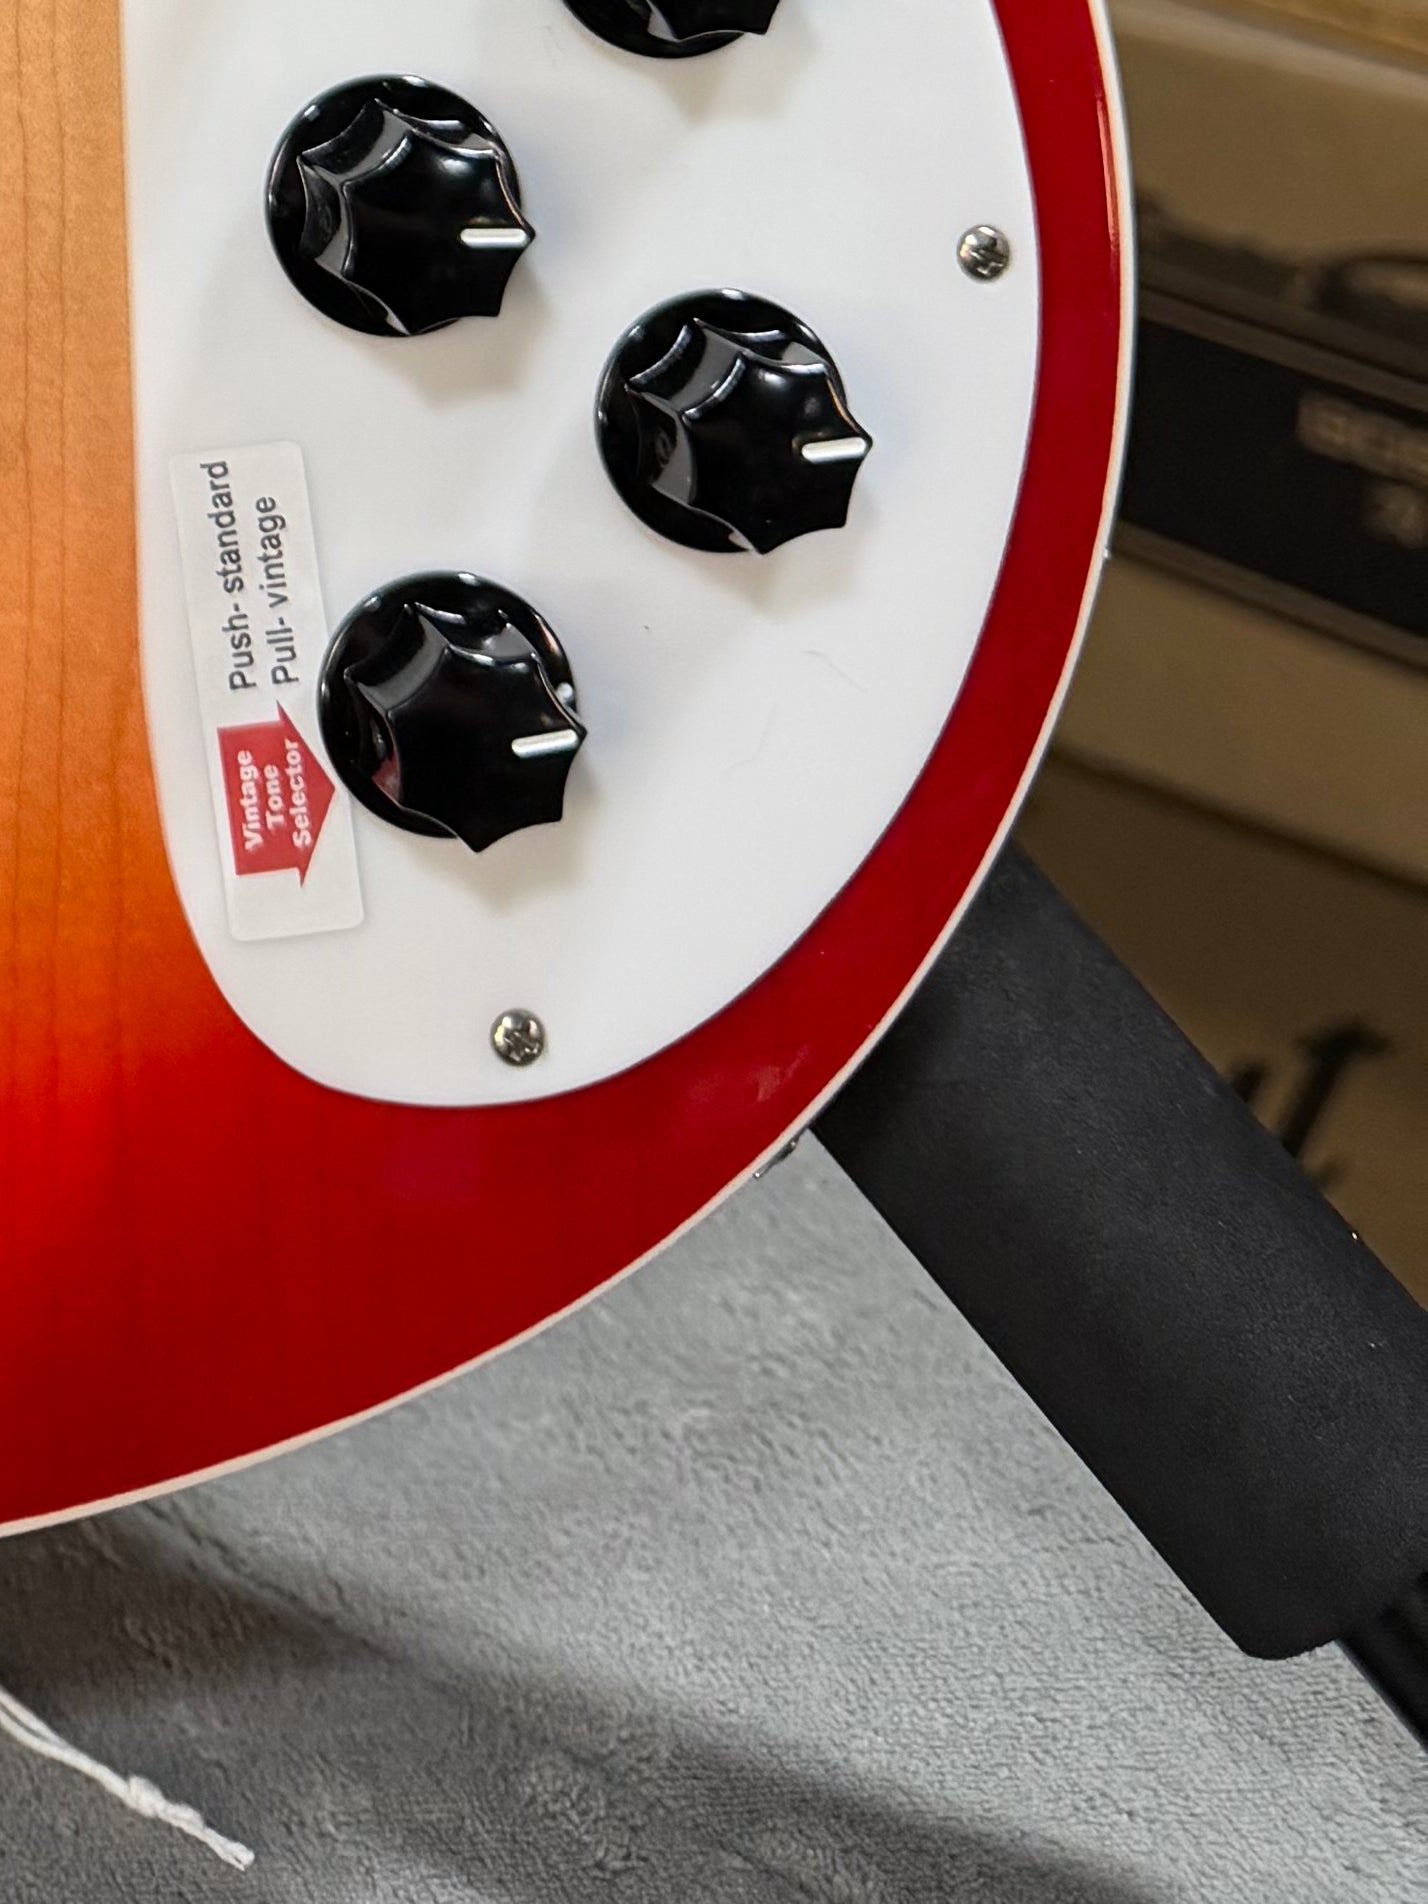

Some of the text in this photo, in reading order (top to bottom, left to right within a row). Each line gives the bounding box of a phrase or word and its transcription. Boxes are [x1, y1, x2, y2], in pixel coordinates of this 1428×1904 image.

[199, 460, 257, 691] Push- standard
[255, 496, 299, 685] Pull- vintage
[237, 749, 264, 851] Vintage
[264, 763, 287, 831] Tone
[284, 737, 313, 849] Selector
